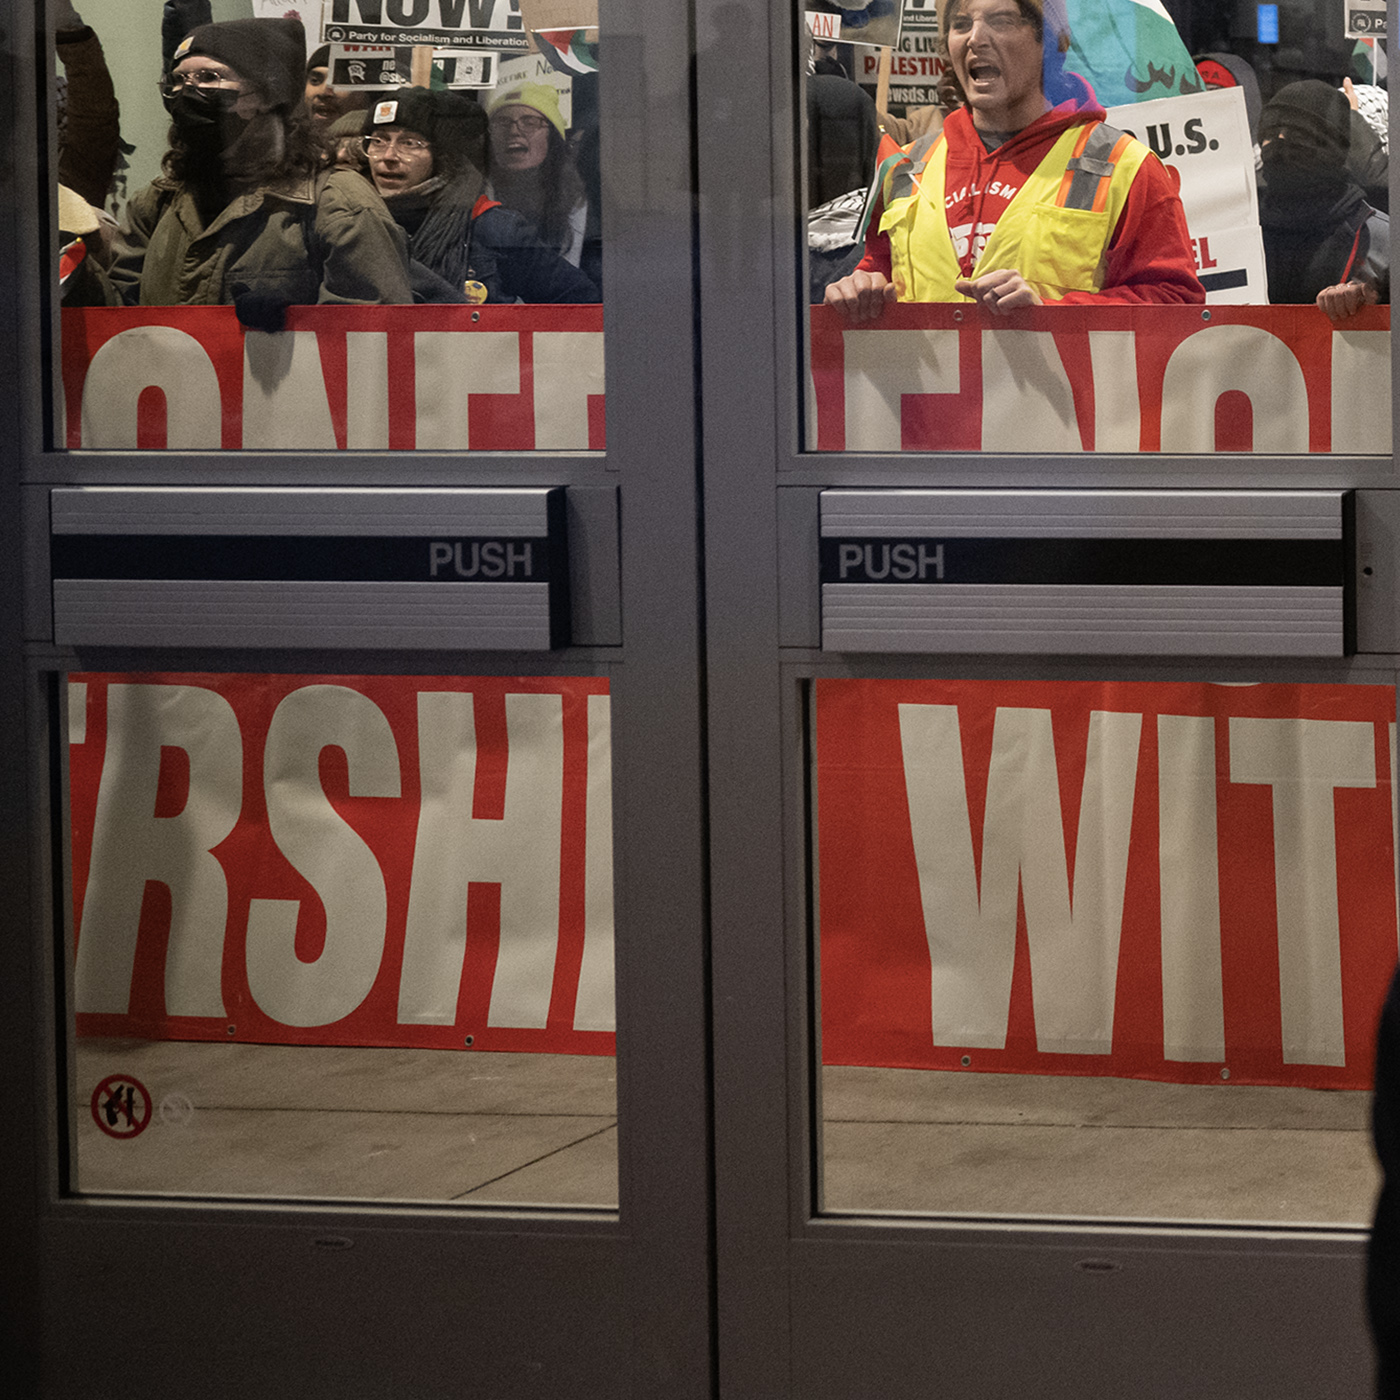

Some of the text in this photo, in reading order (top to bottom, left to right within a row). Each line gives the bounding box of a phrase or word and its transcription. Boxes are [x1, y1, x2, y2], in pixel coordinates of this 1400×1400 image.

[349, 31, 529, 46] Party for Socialism and Liberation
[1146, 118, 1219, 159] U.S.
[430, 543, 532, 577] PUSH
[838, 544, 945, 580] PUSH
[898, 702, 1399, 1068] WIT
